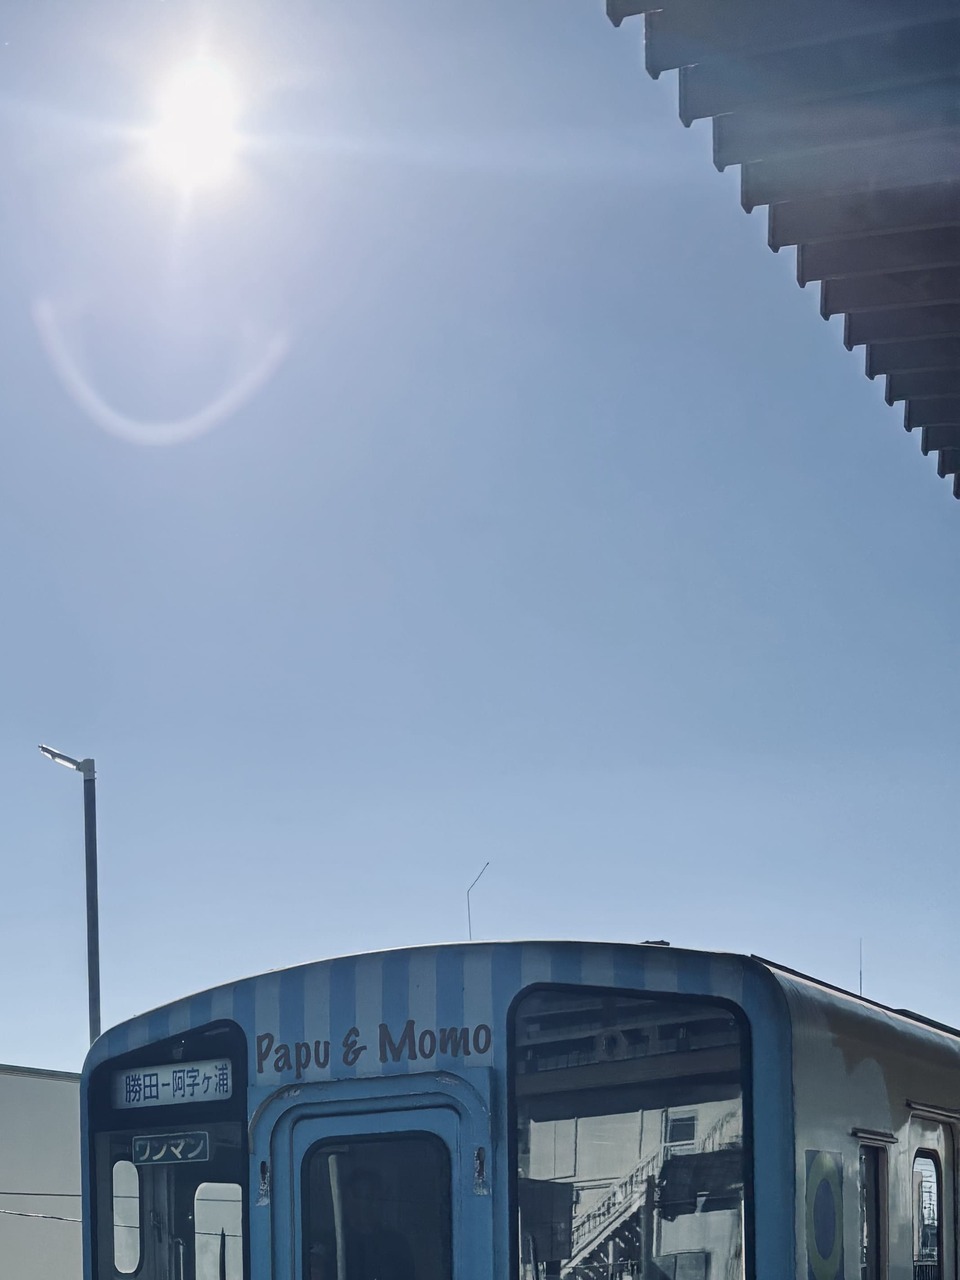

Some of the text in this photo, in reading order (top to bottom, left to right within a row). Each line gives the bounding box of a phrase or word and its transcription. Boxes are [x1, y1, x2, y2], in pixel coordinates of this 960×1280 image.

[256, 1019, 491, 1079] Papu & Momo
